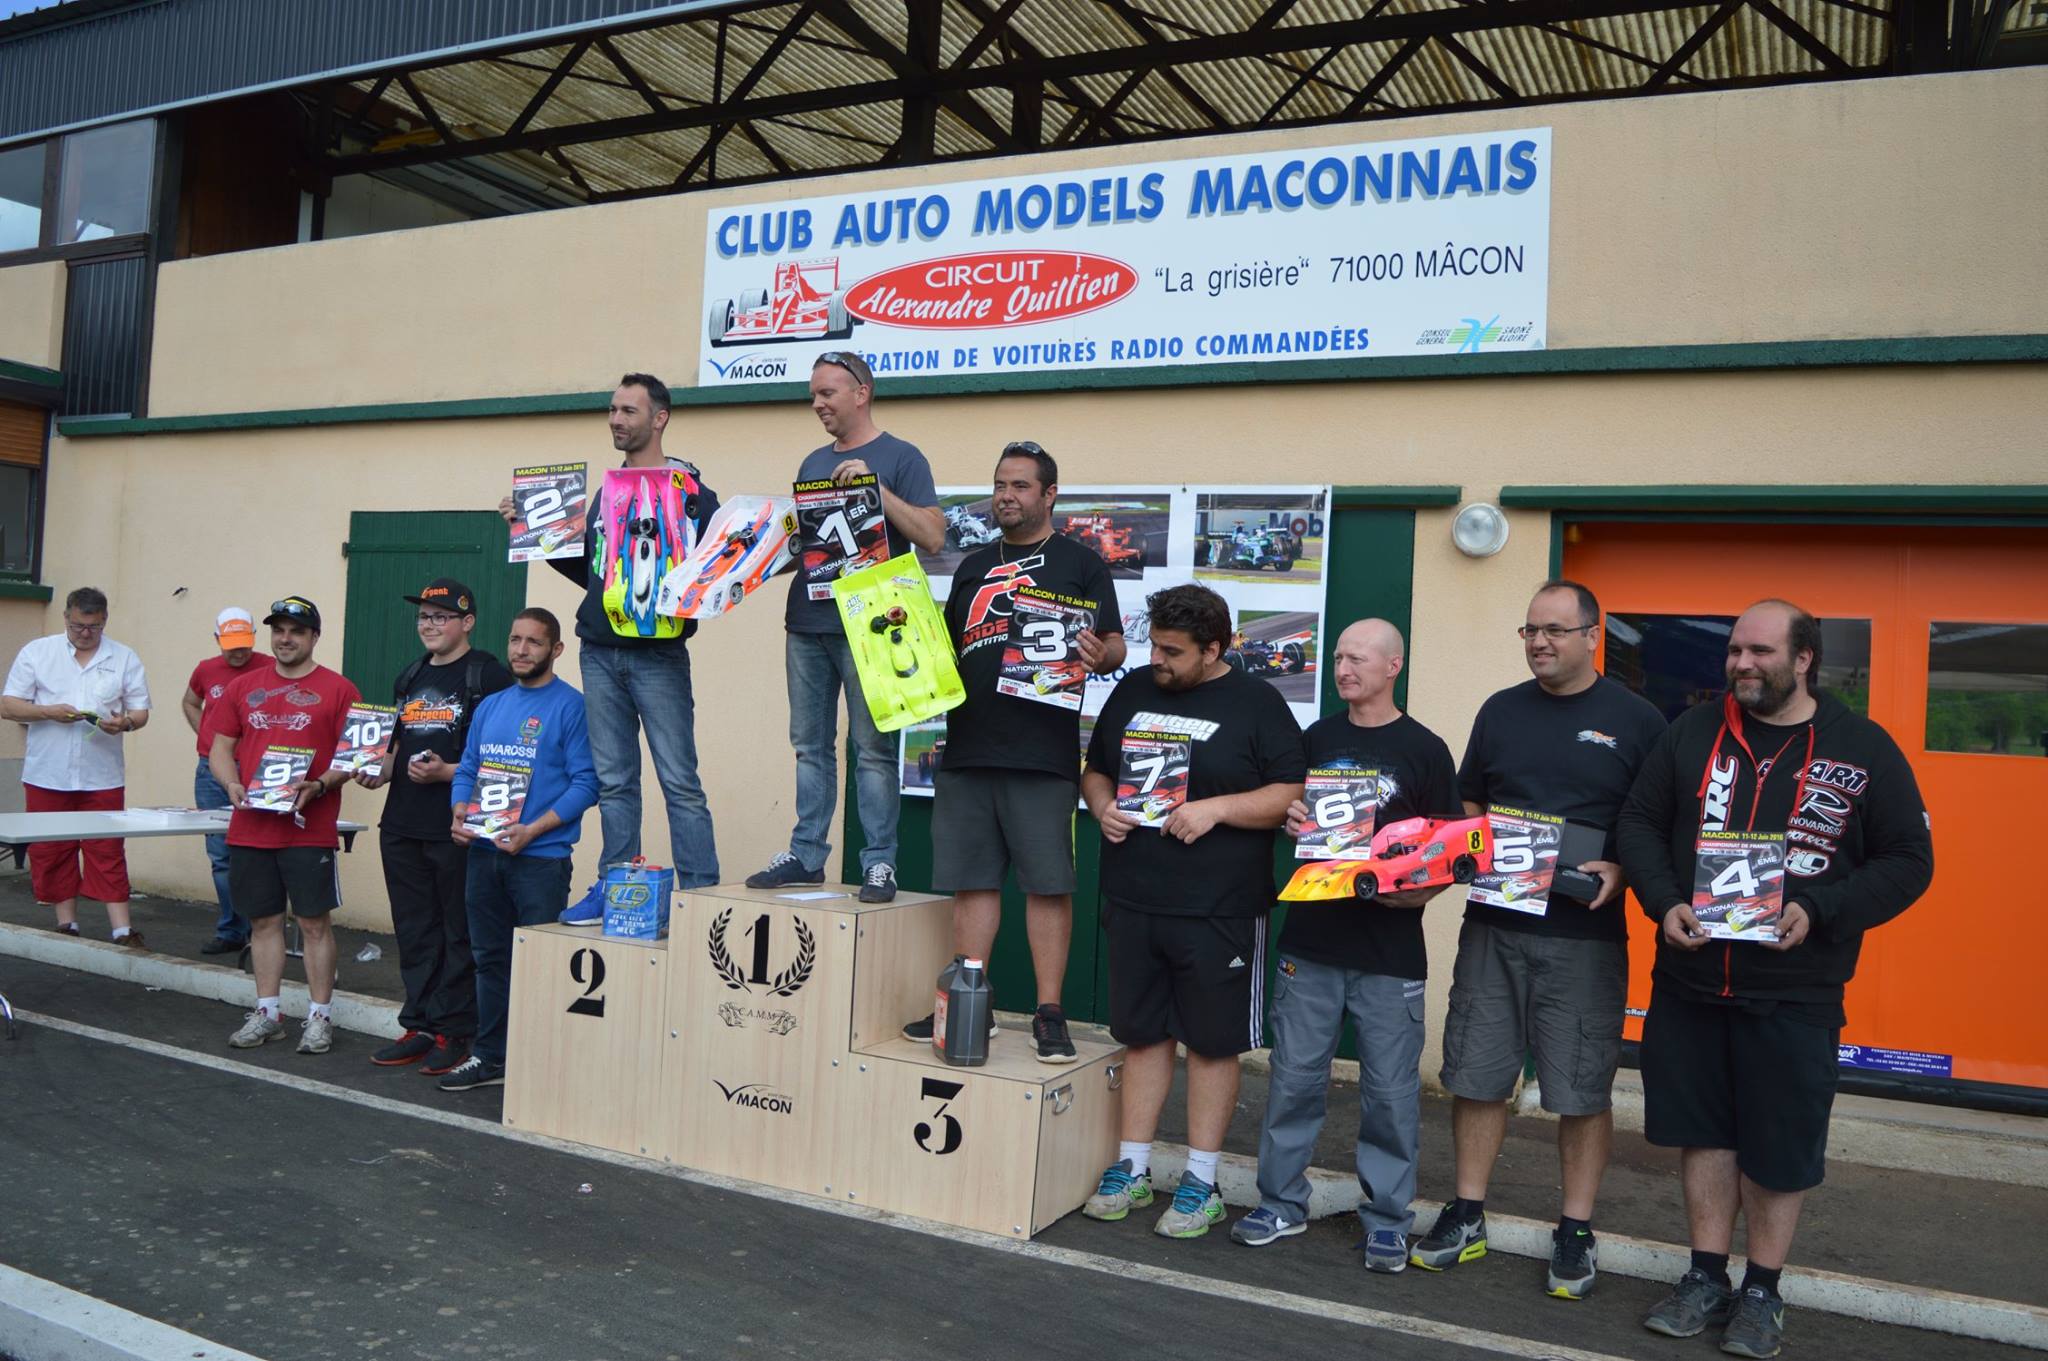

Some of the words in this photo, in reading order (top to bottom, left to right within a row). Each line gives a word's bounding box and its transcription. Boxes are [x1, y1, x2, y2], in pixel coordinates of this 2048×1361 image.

[717, 209, 813, 257] CLUB
[832, 194, 950, 246] AUTO
[972, 171, 1165, 236] MODELS
[1187, 139, 1538, 219] MACONNAIS
[925, 259, 1044, 288] CIRCUIT
[1330, 252, 1403, 283] 71000
[1415, 242, 1525, 278] MÂCON
[858, 286, 993, 320] Alexandre
[1004, 264, 1119, 322] Quillien
[953, 347, 978, 368] DE
[992, 341, 1097, 365] VOITURES
[1110, 335, 1184, 360] RADIO
[1194, 326, 1370, 356] COMMANDÉES
[730, 363, 786, 379] MACON
[516, 467, 548, 475] MACON
[796, 481, 832, 491] MACON
[523, 488, 567, 530] 2
[1268, 511, 1323, 536] Mob
[816, 509, 860, 558] 1
[849, 504, 868, 518] ER
[1019, 586, 1056, 599] MACON
[1022, 621, 1067, 662] 3
[345, 721, 381, 748] 10
[1126, 731, 1154, 739] MACON
[480, 743, 537, 759] NOVAROSSI
[263, 763, 291, 787] 9
[1131, 756, 1165, 794] 7
[481, 783, 509, 812] 8
[1315, 792, 1355, 828] 6
[1490, 805, 1524, 817] MACON
[1471, 831, 1480, 849] 8
[1790, 816, 1842, 835] NOVAROSSI
[1493, 836, 1534, 872] 5
[1710, 859, 1759, 898] 4
[745, 914, 771, 985] 1
[566, 948, 606, 1018] 2
[736, 1093, 793, 1114] MACON
[913, 1077, 964, 1155] 3
